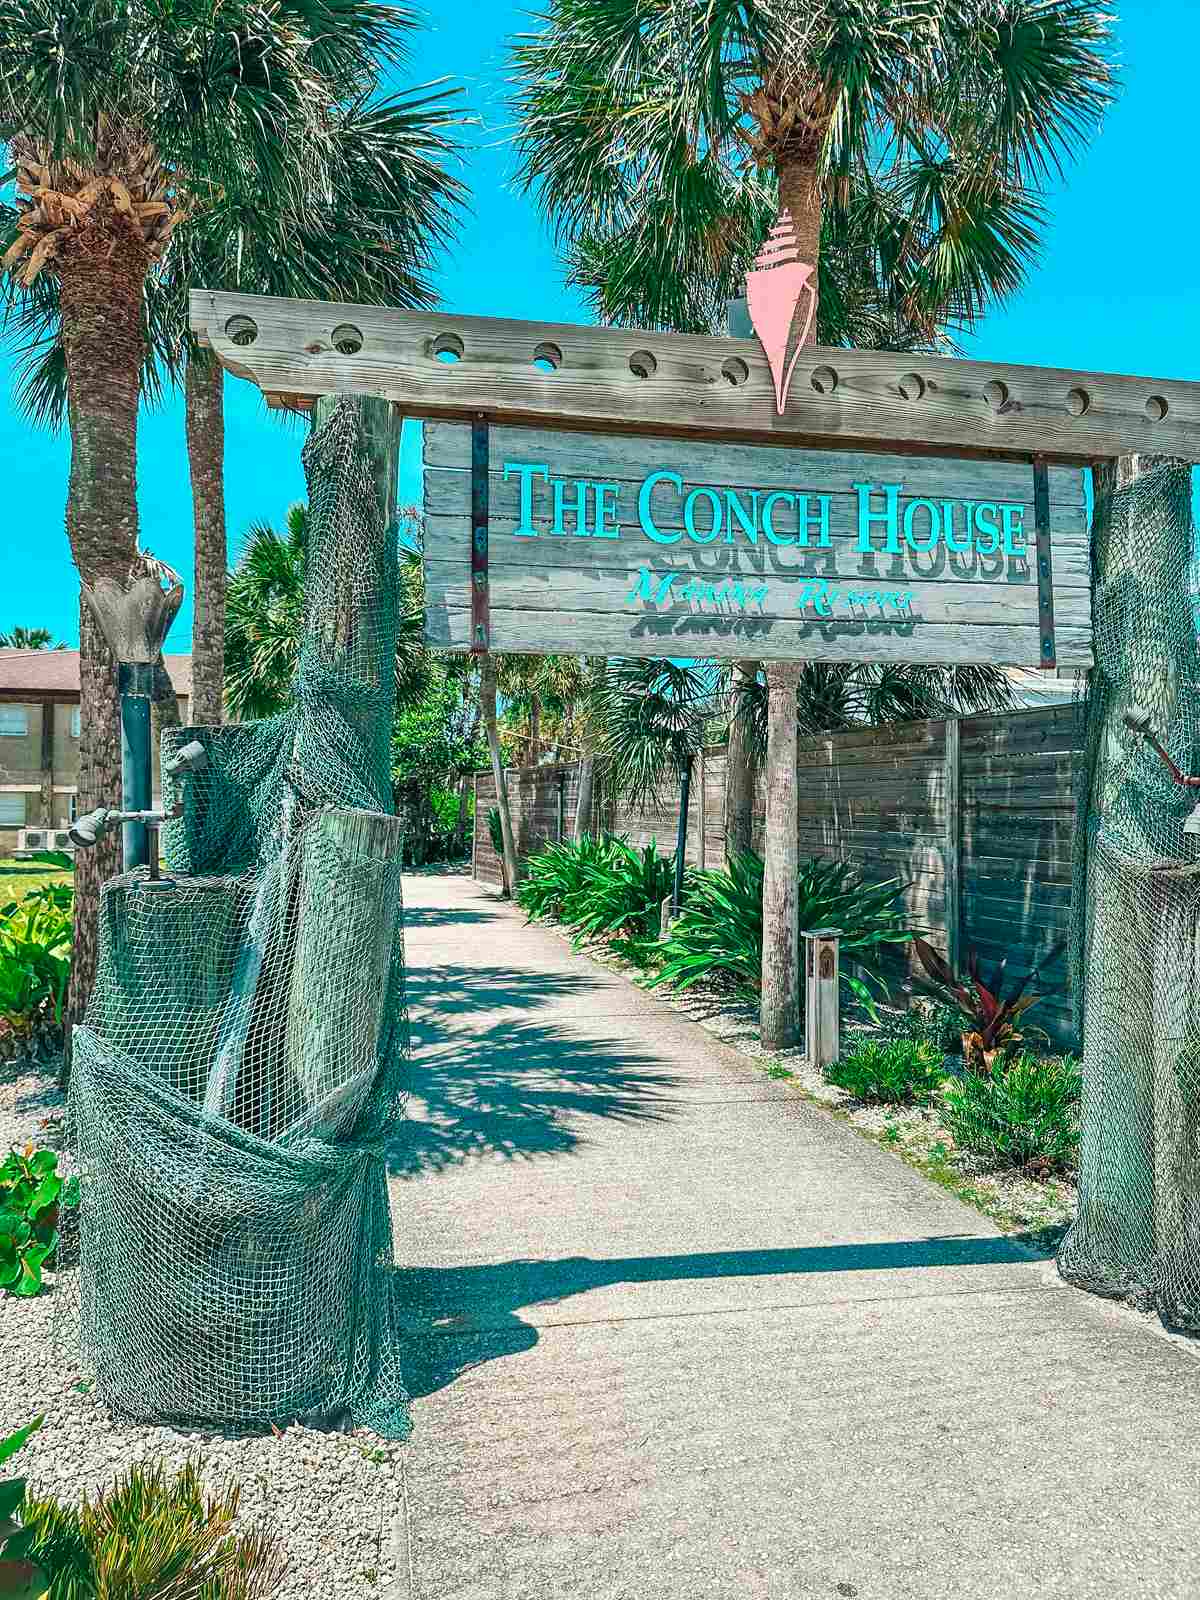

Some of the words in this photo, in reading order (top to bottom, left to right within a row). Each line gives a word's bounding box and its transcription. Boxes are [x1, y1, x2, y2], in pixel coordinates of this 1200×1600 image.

[503, 462, 621, 539] THE
[638, 470, 833, 548] CONCH
[852, 482, 1026, 556] HOUSE
